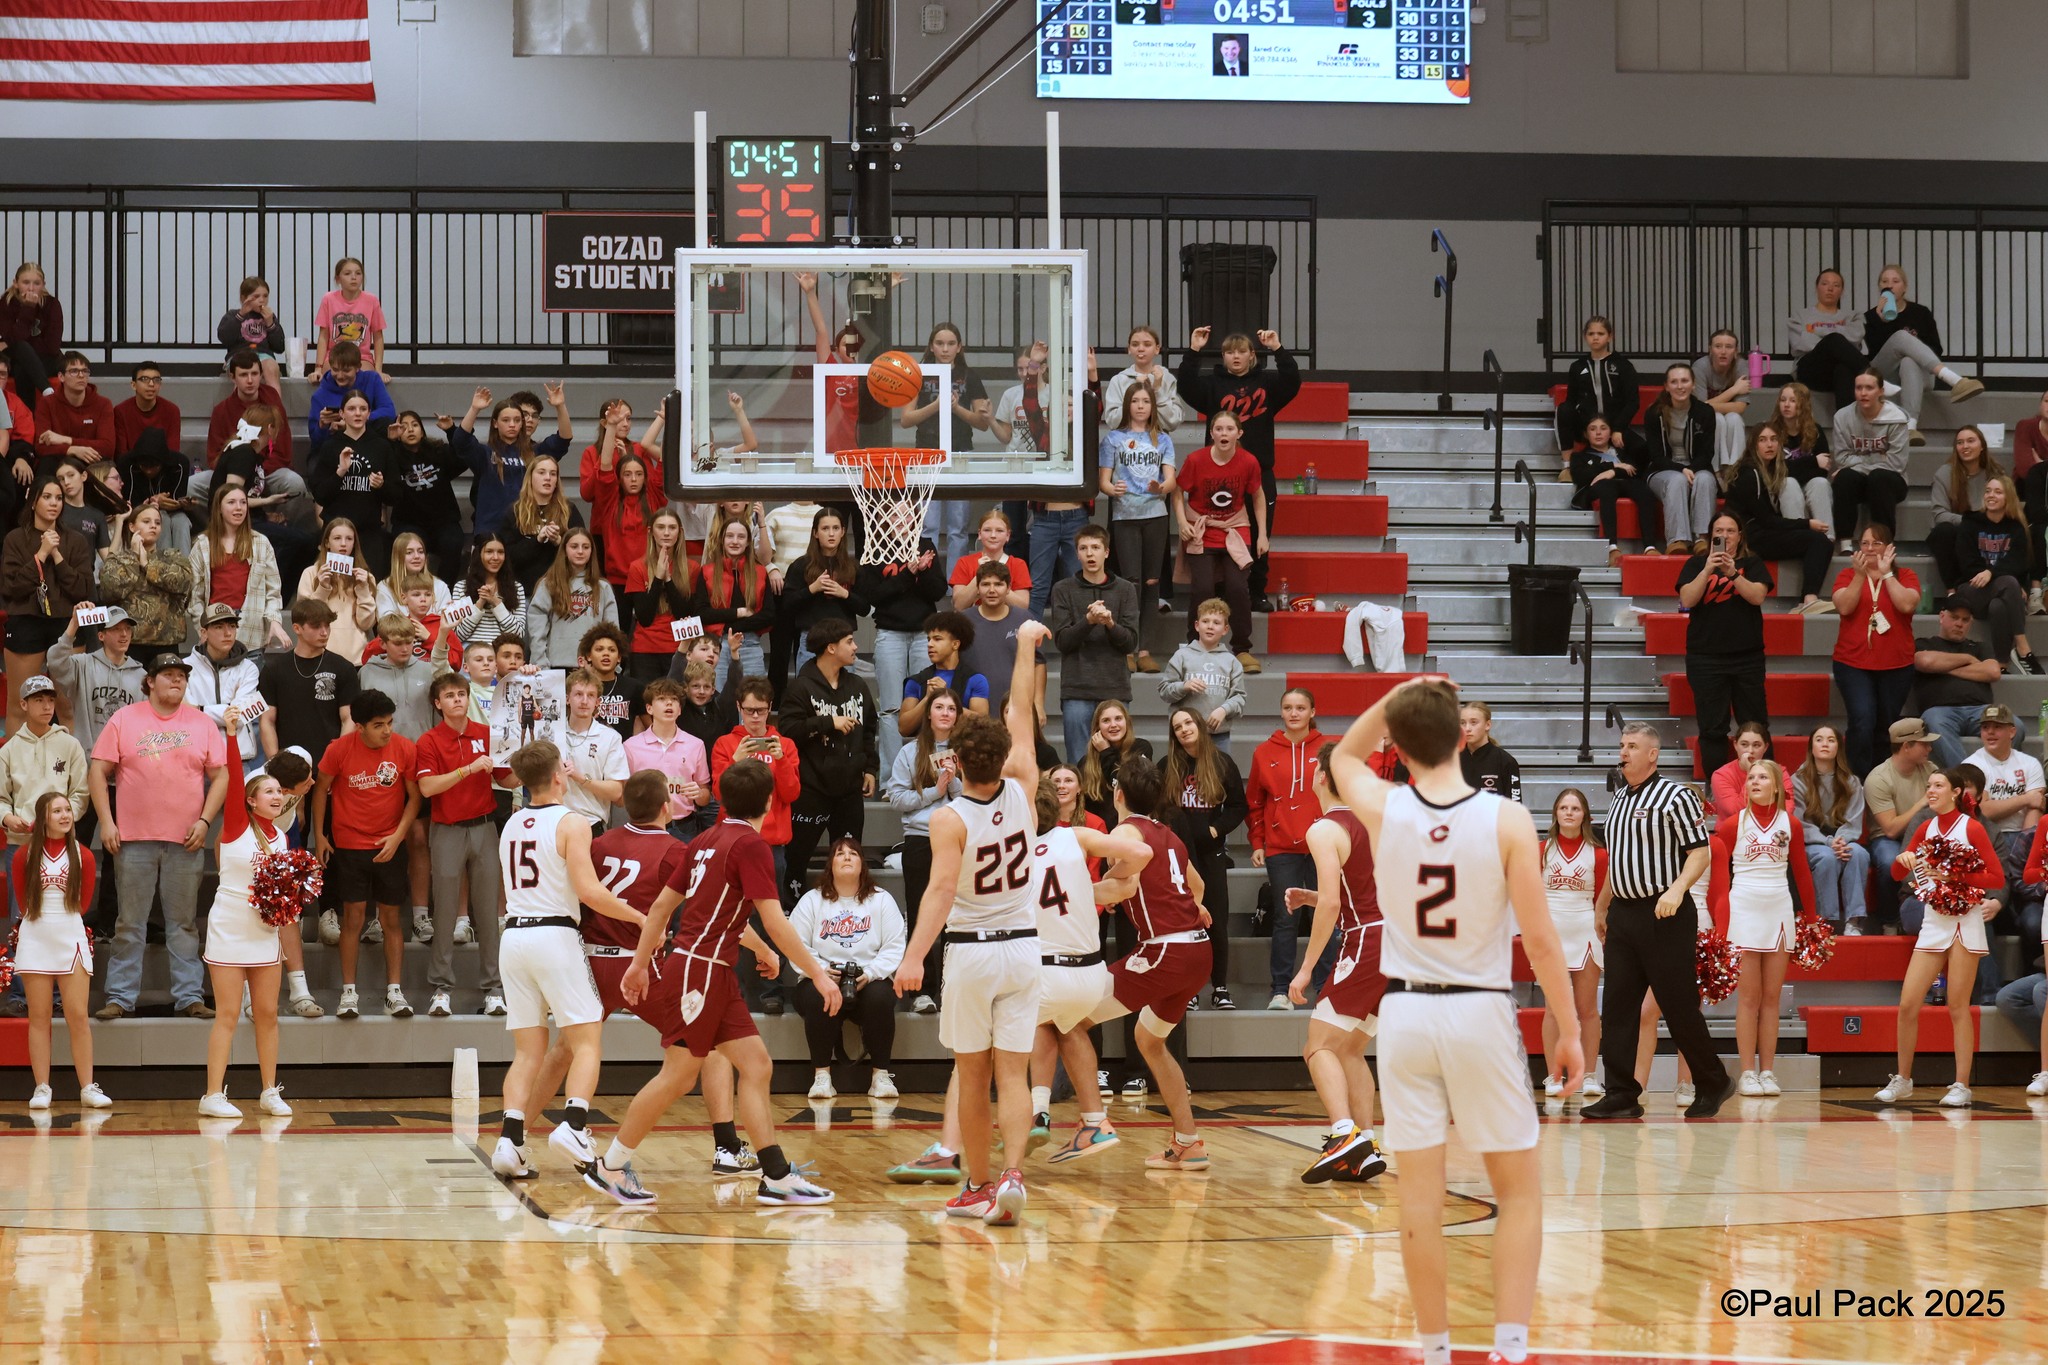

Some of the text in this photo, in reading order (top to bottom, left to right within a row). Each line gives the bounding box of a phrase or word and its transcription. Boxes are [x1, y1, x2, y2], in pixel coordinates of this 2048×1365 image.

[1097, 9, 1105, 19] 2
[1132, 6, 1146, 24] 2
[1213, 0, 1294, 23] 04:51
[1362, 10, 1376, 28] 3
[1399, 12, 1459, 25] 30 5 1
[1045, 24, 1105, 37] 22 16 2
[1399, 30, 1459, 43] 22 3 2
[1049, 42, 1105, 55] 4 11 1
[1132, 40, 1161, 48] Contact
[1399, 47, 1459, 60] 33 2 0
[1046, 60, 1105, 72] 15 7 3
[1399, 65, 1419, 78] 35
[1426, 67, 1440, 77] 15
[1451, 67, 1459, 78] 1
[729, 141, 820, 177] 04:51
[736, 184, 820, 242] 35
[582, 236, 663, 261] COZAD
[555, 264, 674, 290] STUDENT
[923, 380, 967, 394] BLCK
[1220, 387, 1268, 423] 222
[341, 475, 371, 492] SKETBALL
[329, 560, 350, 574] 1000
[1703, 568, 1745, 605] 22
[81, 613, 105, 625] 1000
[449, 605, 472, 624] 1000
[675, 624, 700, 640] 1000
[241, 700, 265, 722] 1000
[478, 699, 492, 711] NIK
[471, 739, 486, 754] N
[523, 817, 536, 829] C
[991, 811, 1004, 826] C
[1428, 825, 1449, 843] C
[1034, 843, 1048, 857] C
[1750, 846, 1780, 855] MAKERS
[509, 840, 540, 890] 15
[974, 829, 1030, 895] 22
[1168, 848, 1187, 894] 4
[600, 856, 641, 904] 22
[1551, 877, 1584, 888] MAKERS
[1038, 865, 1069, 916] 4
[1416, 863, 1457, 939] 2
[819, 914, 872, 936] Volleyball
